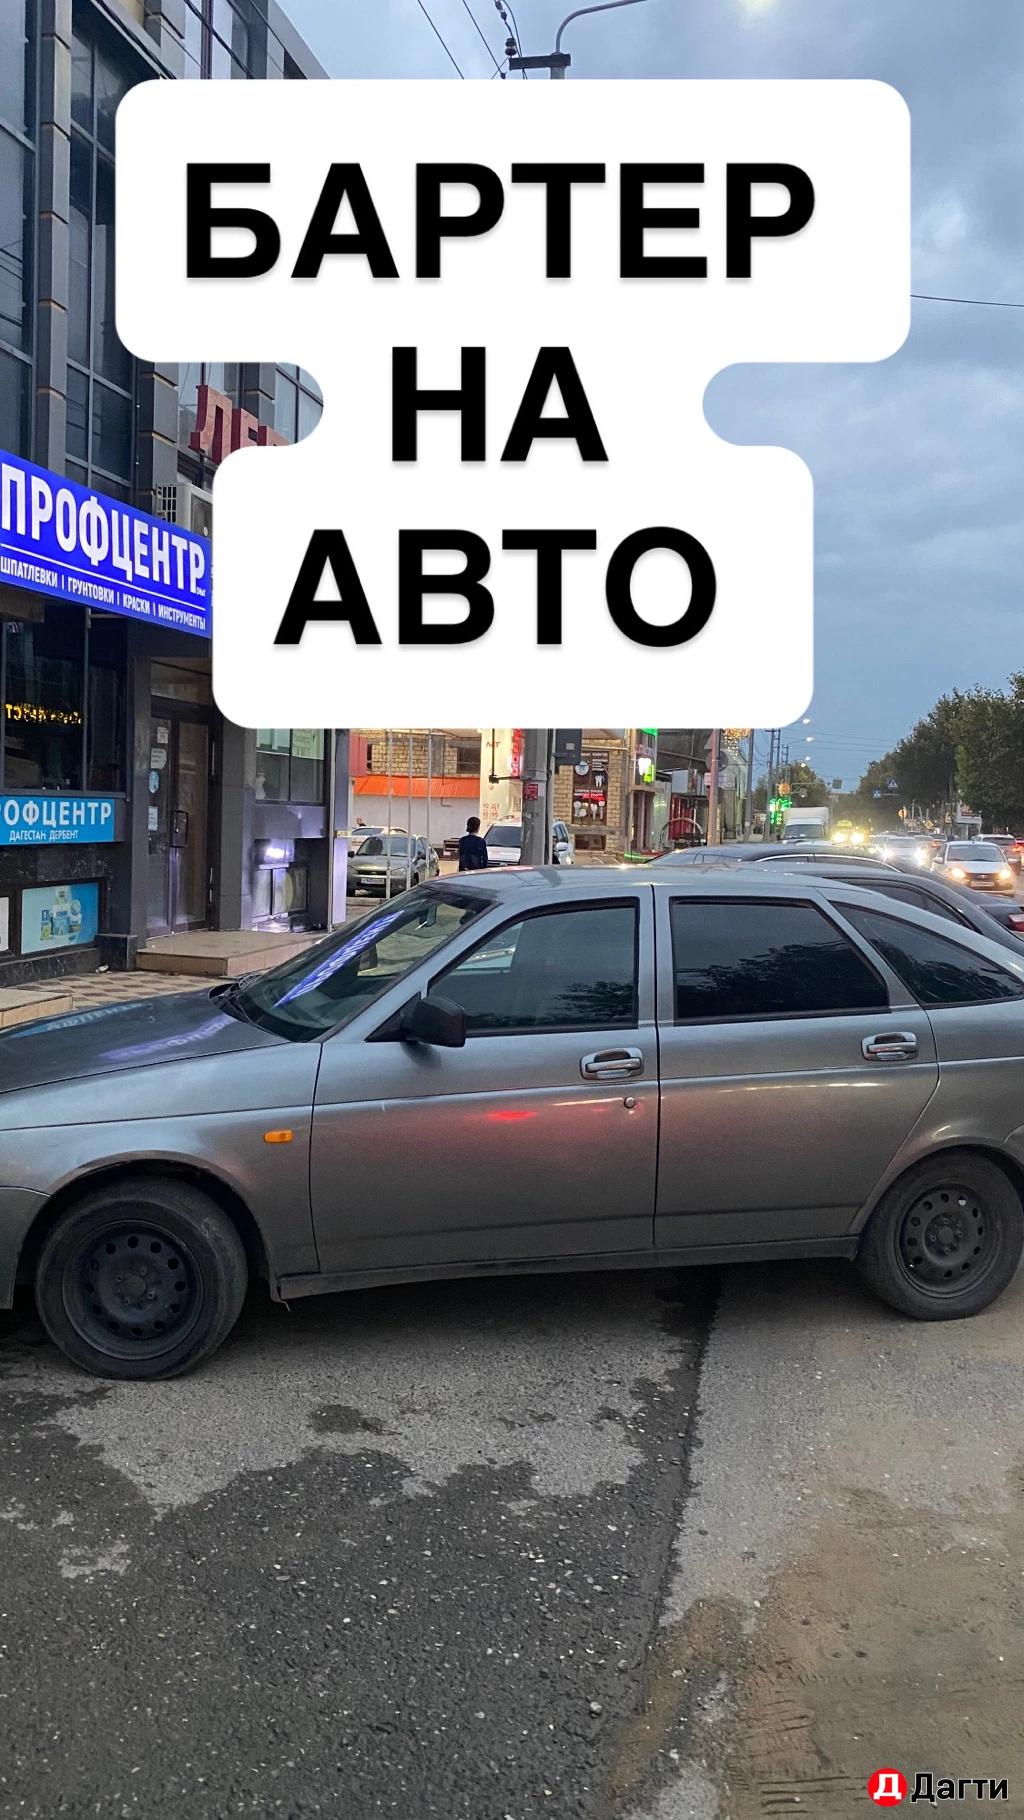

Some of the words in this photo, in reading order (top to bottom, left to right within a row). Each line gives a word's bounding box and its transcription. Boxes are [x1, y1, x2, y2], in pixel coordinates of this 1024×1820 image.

[1, 462, 205, 593] ПРОФЦЕНТР
[0, 556, 58, 588] ШПАТЛЕВКИ
[67, 576, 114, 605] ГРУНТОВКИ
[123, 593, 150, 614] КРАСКИ
[158, 603, 206, 630] ИНСТРУМЕНТЫ
[0, 799, 112, 828] ОФЦЕНТР
[9, 830, 46, 842] ДАГЕСТАН
[49, 830, 79, 842] ДЕРБЕНТ
